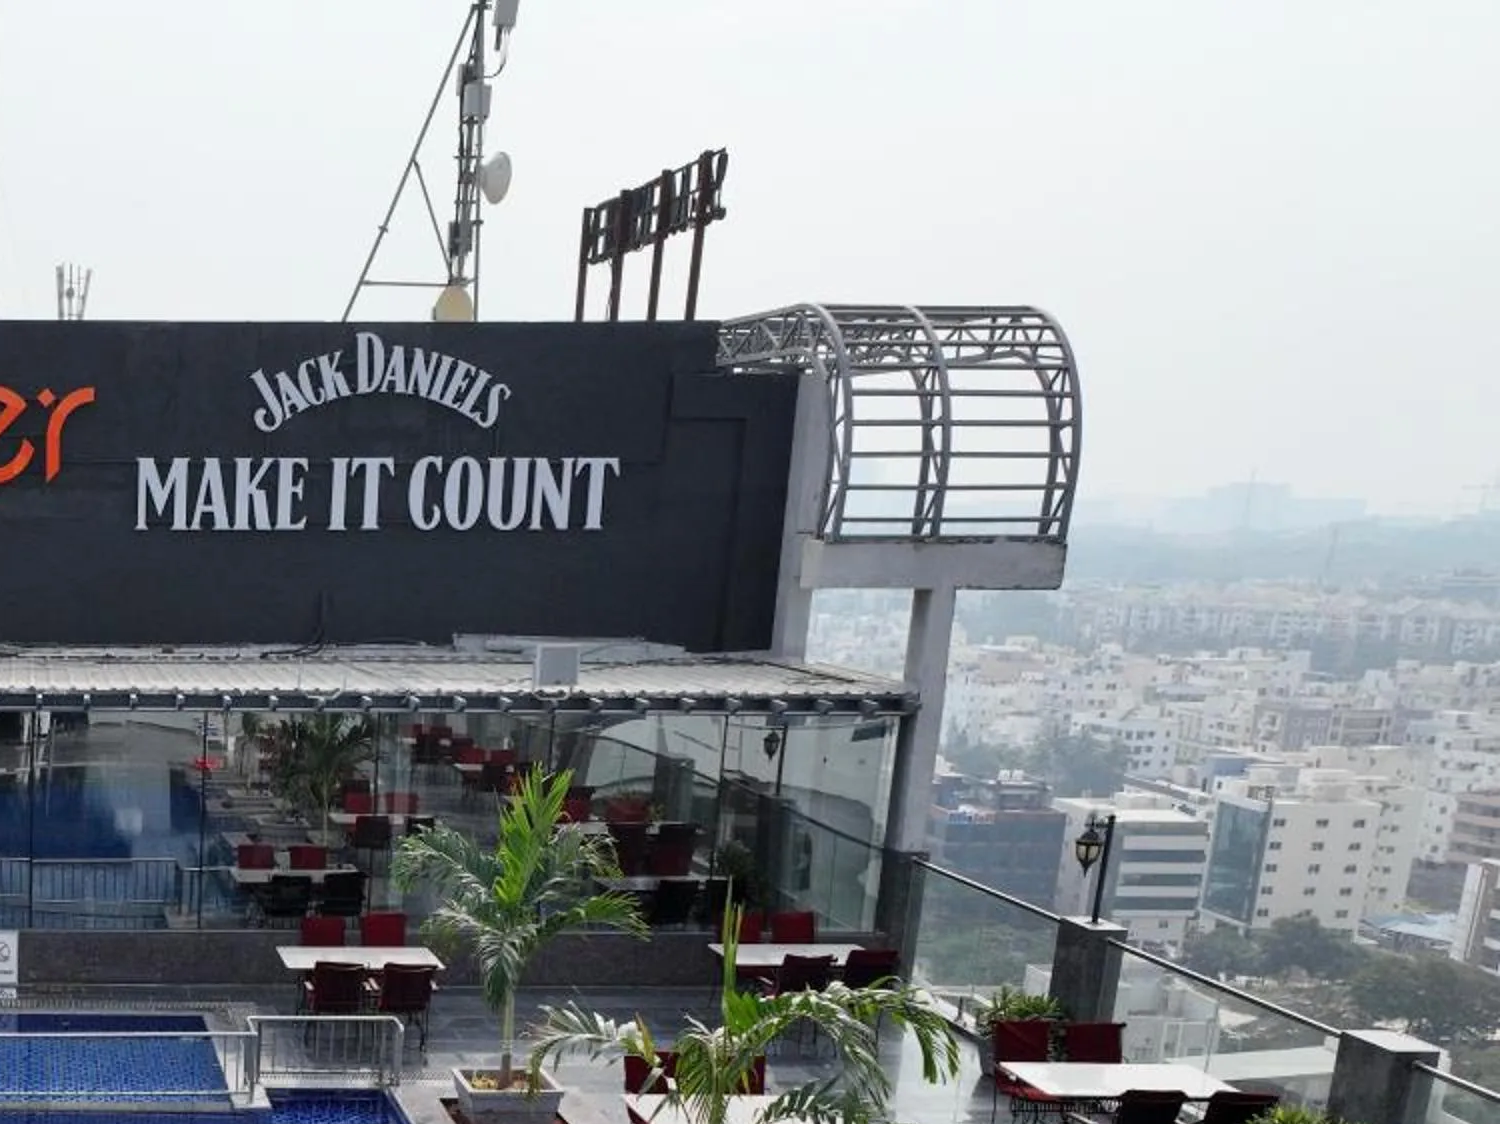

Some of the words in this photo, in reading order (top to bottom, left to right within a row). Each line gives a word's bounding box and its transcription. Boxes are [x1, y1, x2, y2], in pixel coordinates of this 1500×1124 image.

[250, 349, 352, 432] JACK
[354, 331, 513, 429] DANIELS
[134, 456, 308, 531] MAKE
[327, 456, 394, 531] IT
[408, 455, 621, 531] COUNT
